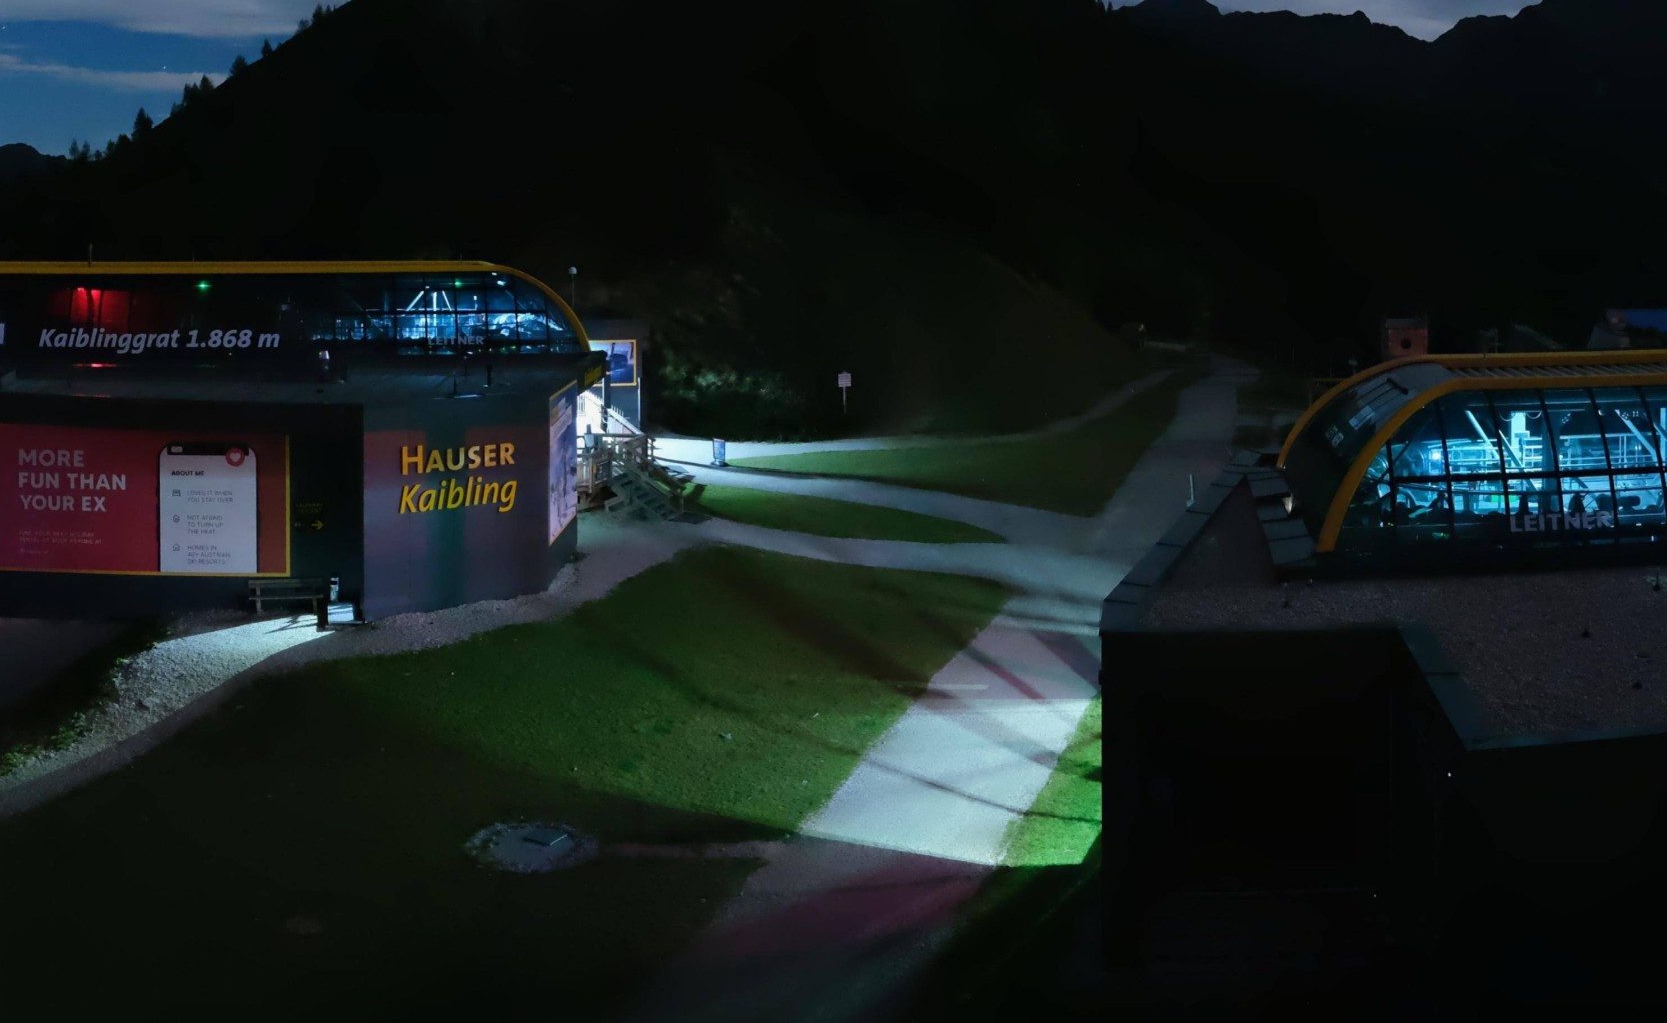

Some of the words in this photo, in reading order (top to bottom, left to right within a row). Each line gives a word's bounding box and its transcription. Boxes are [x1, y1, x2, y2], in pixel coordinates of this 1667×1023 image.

[38, 328, 181, 354] Kaiblinggrat
[185, 329, 252, 348] 1.868
[257, 332, 280, 348] m
[428, 336, 485, 346] LEITNER
[18, 448, 85, 467] MORE
[401, 442, 516, 476] HAUSER
[18, 472, 60, 489] FUN
[66, 473, 127, 490] THAN
[20, 495, 75, 511] YOUR
[81, 496, 107, 512] EX
[399, 476, 518, 514] Kaibling
[1510, 510, 1616, 533] LEITNER
